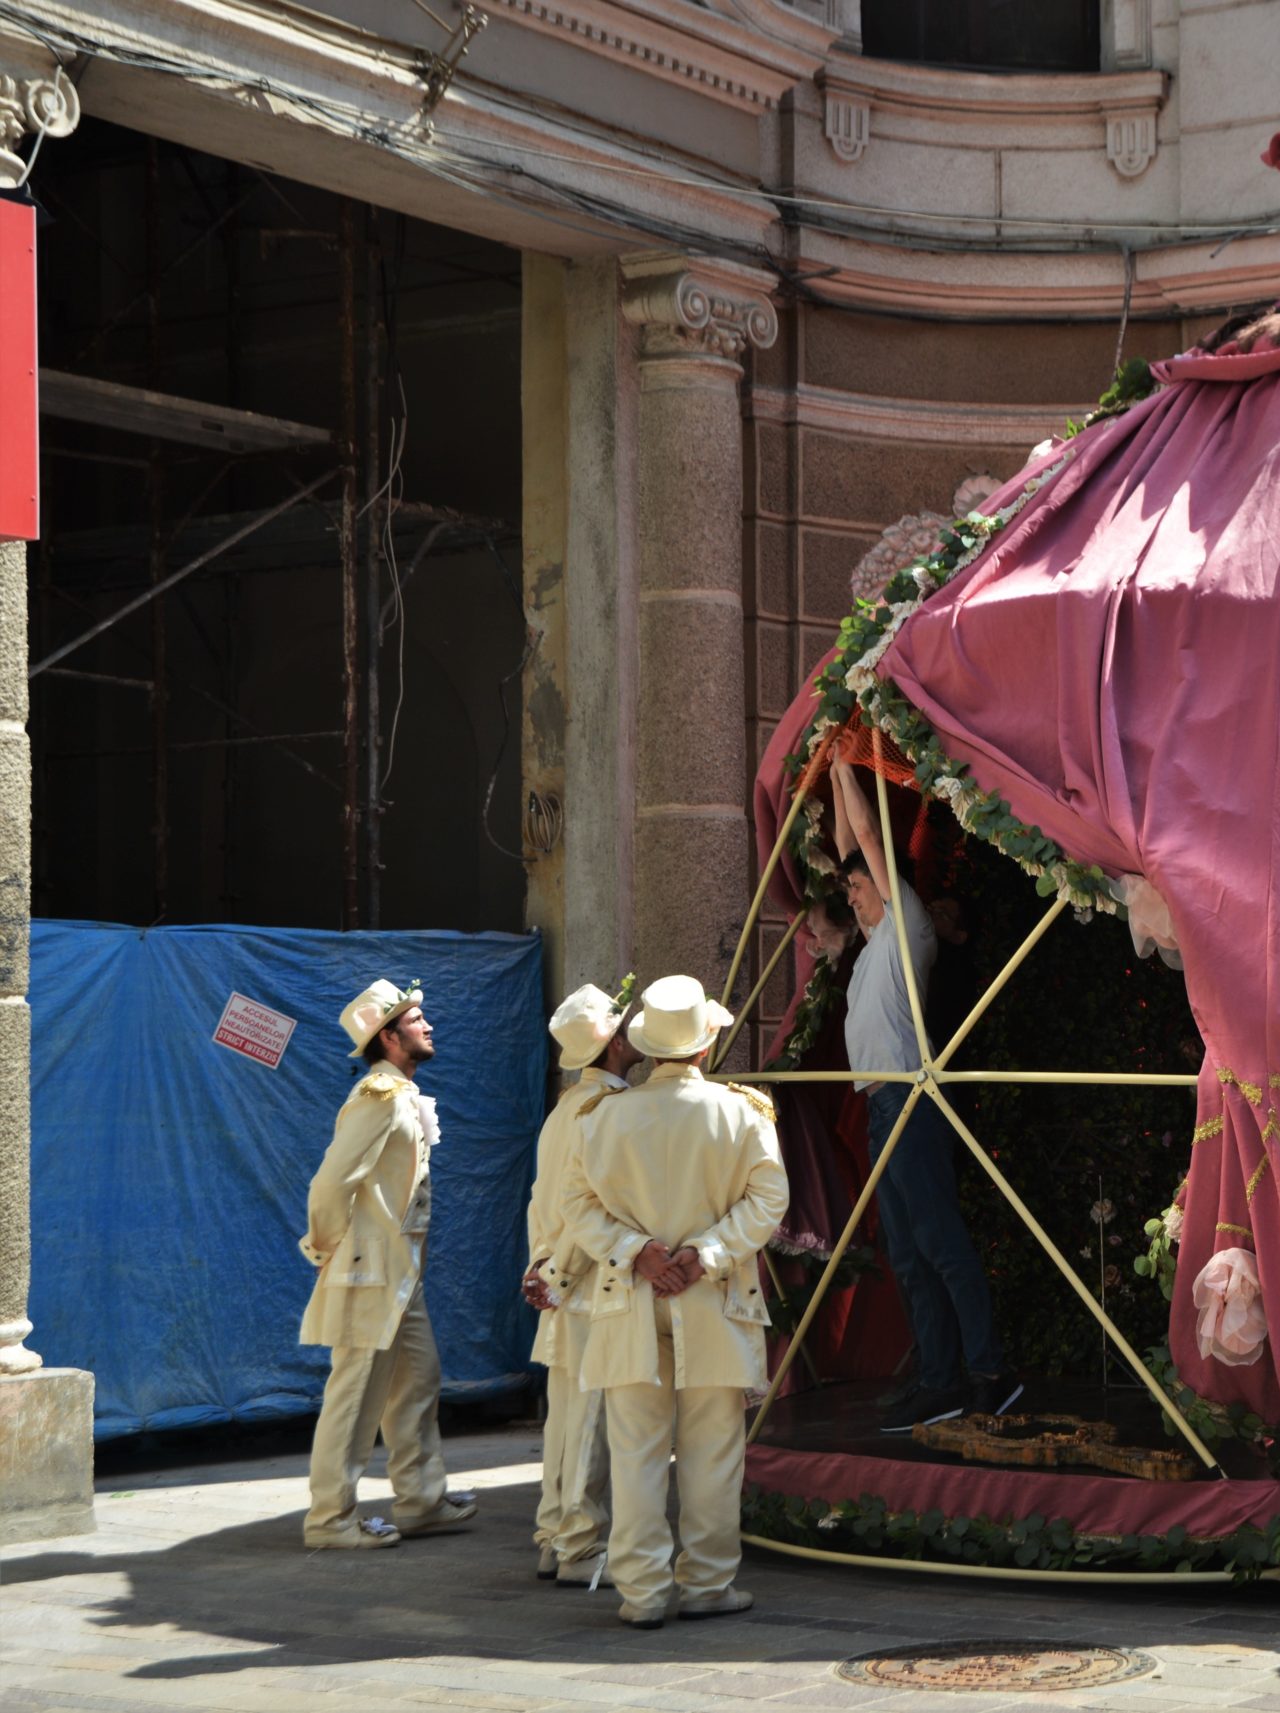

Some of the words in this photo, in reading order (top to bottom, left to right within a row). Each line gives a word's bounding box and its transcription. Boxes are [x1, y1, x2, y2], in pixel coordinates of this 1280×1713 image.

[229, 1010, 285, 1039] PERSOANELOR
[243, 1006, 278, 1026] ACCESUL
[217, 1031, 244, 1048] STRICT
[245, 1041, 278, 1063] INTERZIS
[225, 1019, 282, 1050] NEAUTORIZATE
